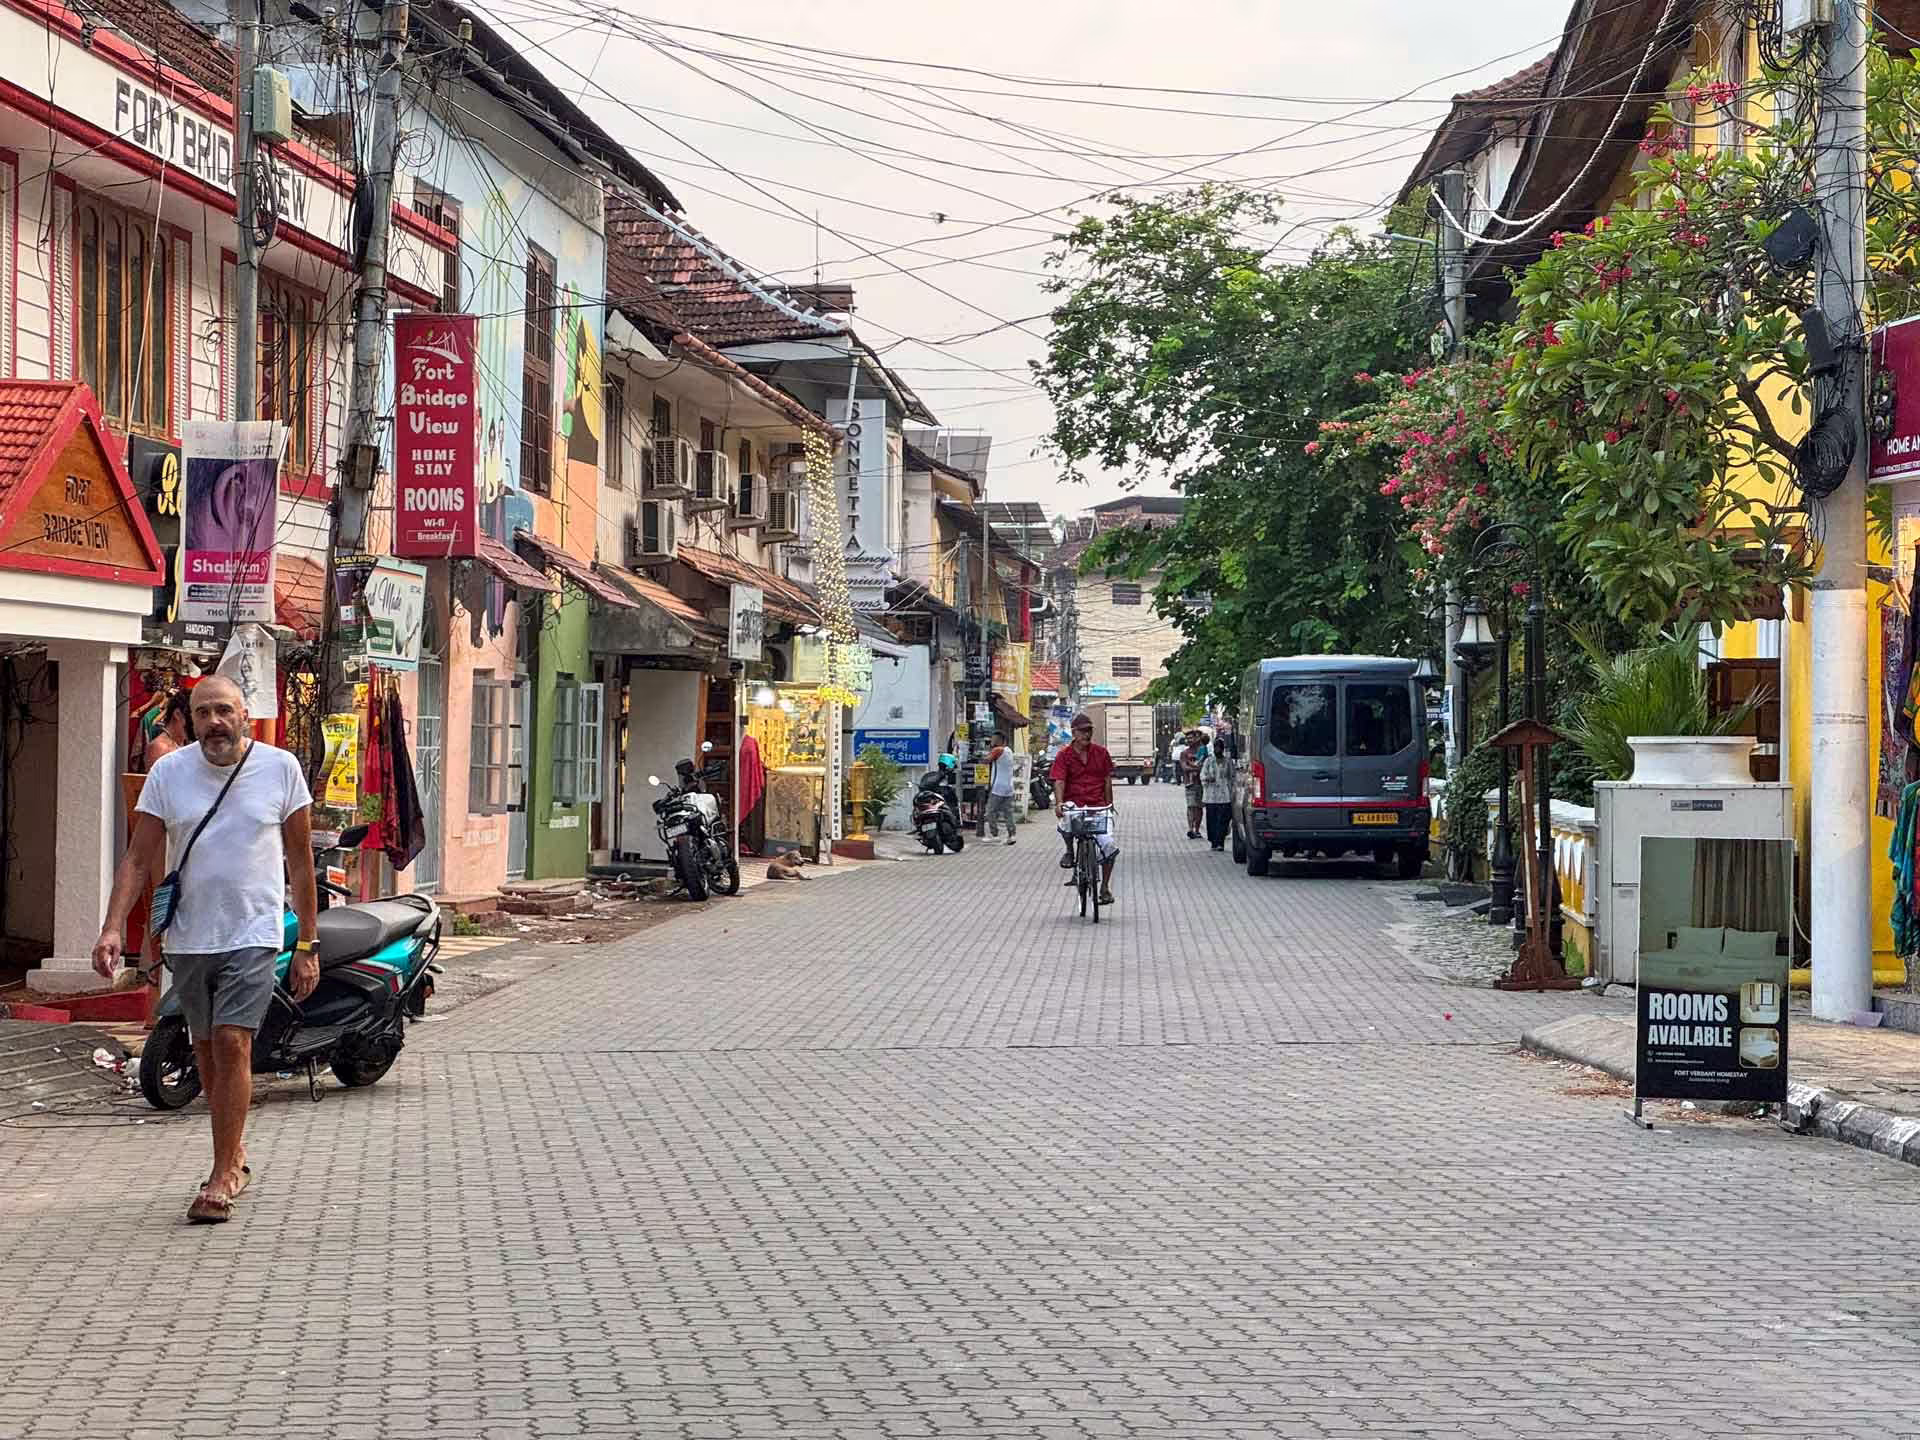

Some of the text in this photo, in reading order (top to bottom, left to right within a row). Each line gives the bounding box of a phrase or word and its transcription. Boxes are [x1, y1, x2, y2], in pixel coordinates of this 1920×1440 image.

[115, 77, 179, 160] FORT
[183, 116, 234, 185] BRID
[412, 357, 455, 380] Fort
[400, 383, 468, 408] Bridge
[409, 411, 459, 434] View
[411, 449, 456, 461] HOME
[1887, 436, 1909, 456] HOME
[415, 463, 453, 475] STAY
[846, 402, 862, 549] SONNETTA
[65, 474, 91, 505] FORT
[404, 487, 465, 512] ROOMS
[43, 511, 110, 550] BRIDGE VIEW
[192, 559, 260, 574] Shabam
[845, 551, 891, 572] idency
[898, 752, 927, 761] Street
[1649, 993, 1728, 1021] ROOMS
[1648, 1025, 1732, 1047] AVAILABLE
